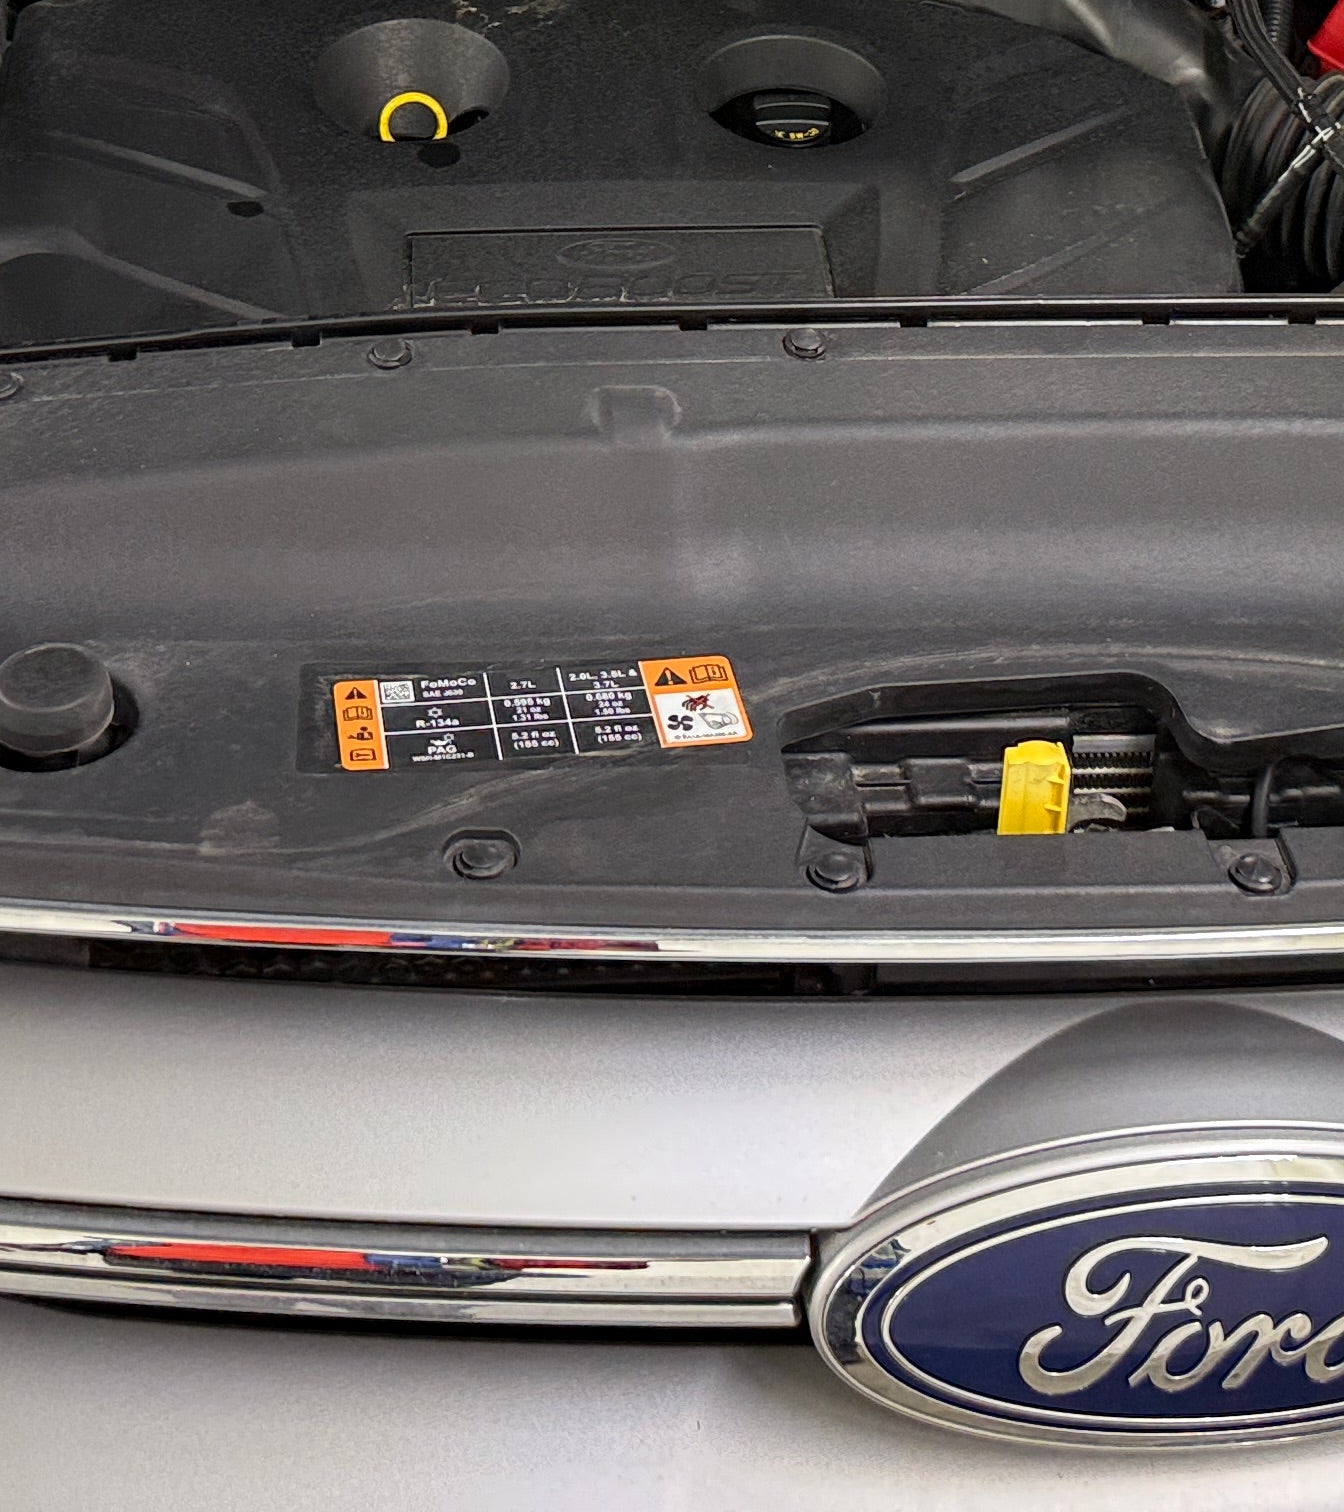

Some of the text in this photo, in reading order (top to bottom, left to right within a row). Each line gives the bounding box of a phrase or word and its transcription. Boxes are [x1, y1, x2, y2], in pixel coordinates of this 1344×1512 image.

[420, 677, 477, 689] FoMoCo
[509, 680, 536, 690] 2.7L
[592, 680, 620, 689] 3.7L
[617, 691, 632, 701] kg
[536, 697, 551, 707] kg
[416, 718, 460, 729] R-134a
[427, 744, 458, 755] PAG
